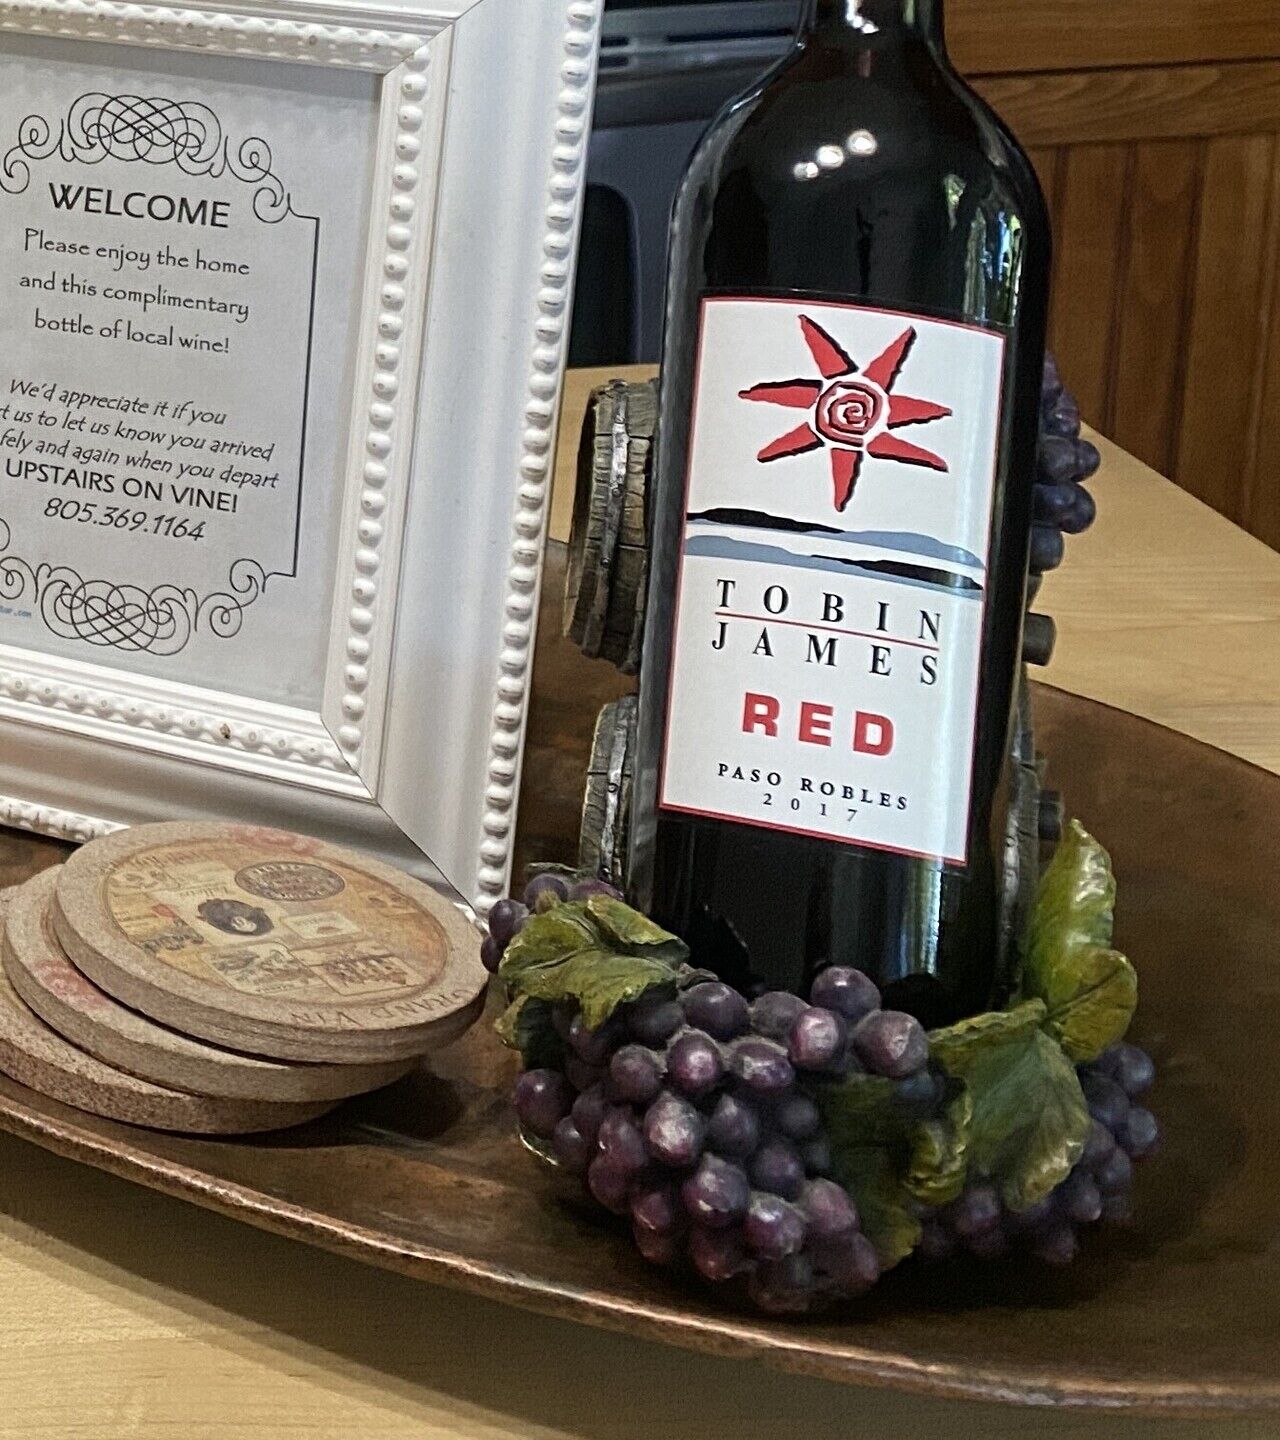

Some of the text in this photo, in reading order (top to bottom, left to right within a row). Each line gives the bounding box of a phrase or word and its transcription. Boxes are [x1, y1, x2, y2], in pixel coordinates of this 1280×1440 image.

[49, 182, 230, 227] WELCOME
[25, 228, 249, 275] Please enjoy the home
[19, 271, 248, 323] and this complimentary
[35, 308, 229, 353] bottle of local wine!
[10, 380, 226, 427] We'd appreciate it if you
[14, 410, 33, 423] us
[38, 411, 57, 427] to
[62, 411, 87, 432] let
[91, 422, 110, 436] us
[116, 423, 166, 442] know
[170, 434, 206, 452] you
[210, 440, 274, 462] arrived
[6, 458, 237, 513] UPSTAIRS ON VINE!
[36, 437, 70, 457] and
[73, 447, 120, 469] again
[125, 453, 172, 473] when
[176, 463, 214, 483] you
[220, 466, 279, 490] depart
[45, 498, 205, 541] 805.369.1164
[717, 579, 941, 642] TOBIN
[712, 622, 938, 686] JAMES
[742, 692, 894, 756] RED
[717, 763, 909, 811] PASO ROBLES
[763, 793, 859, 822] 2017
[369, 988, 474, 1019] GRAND
